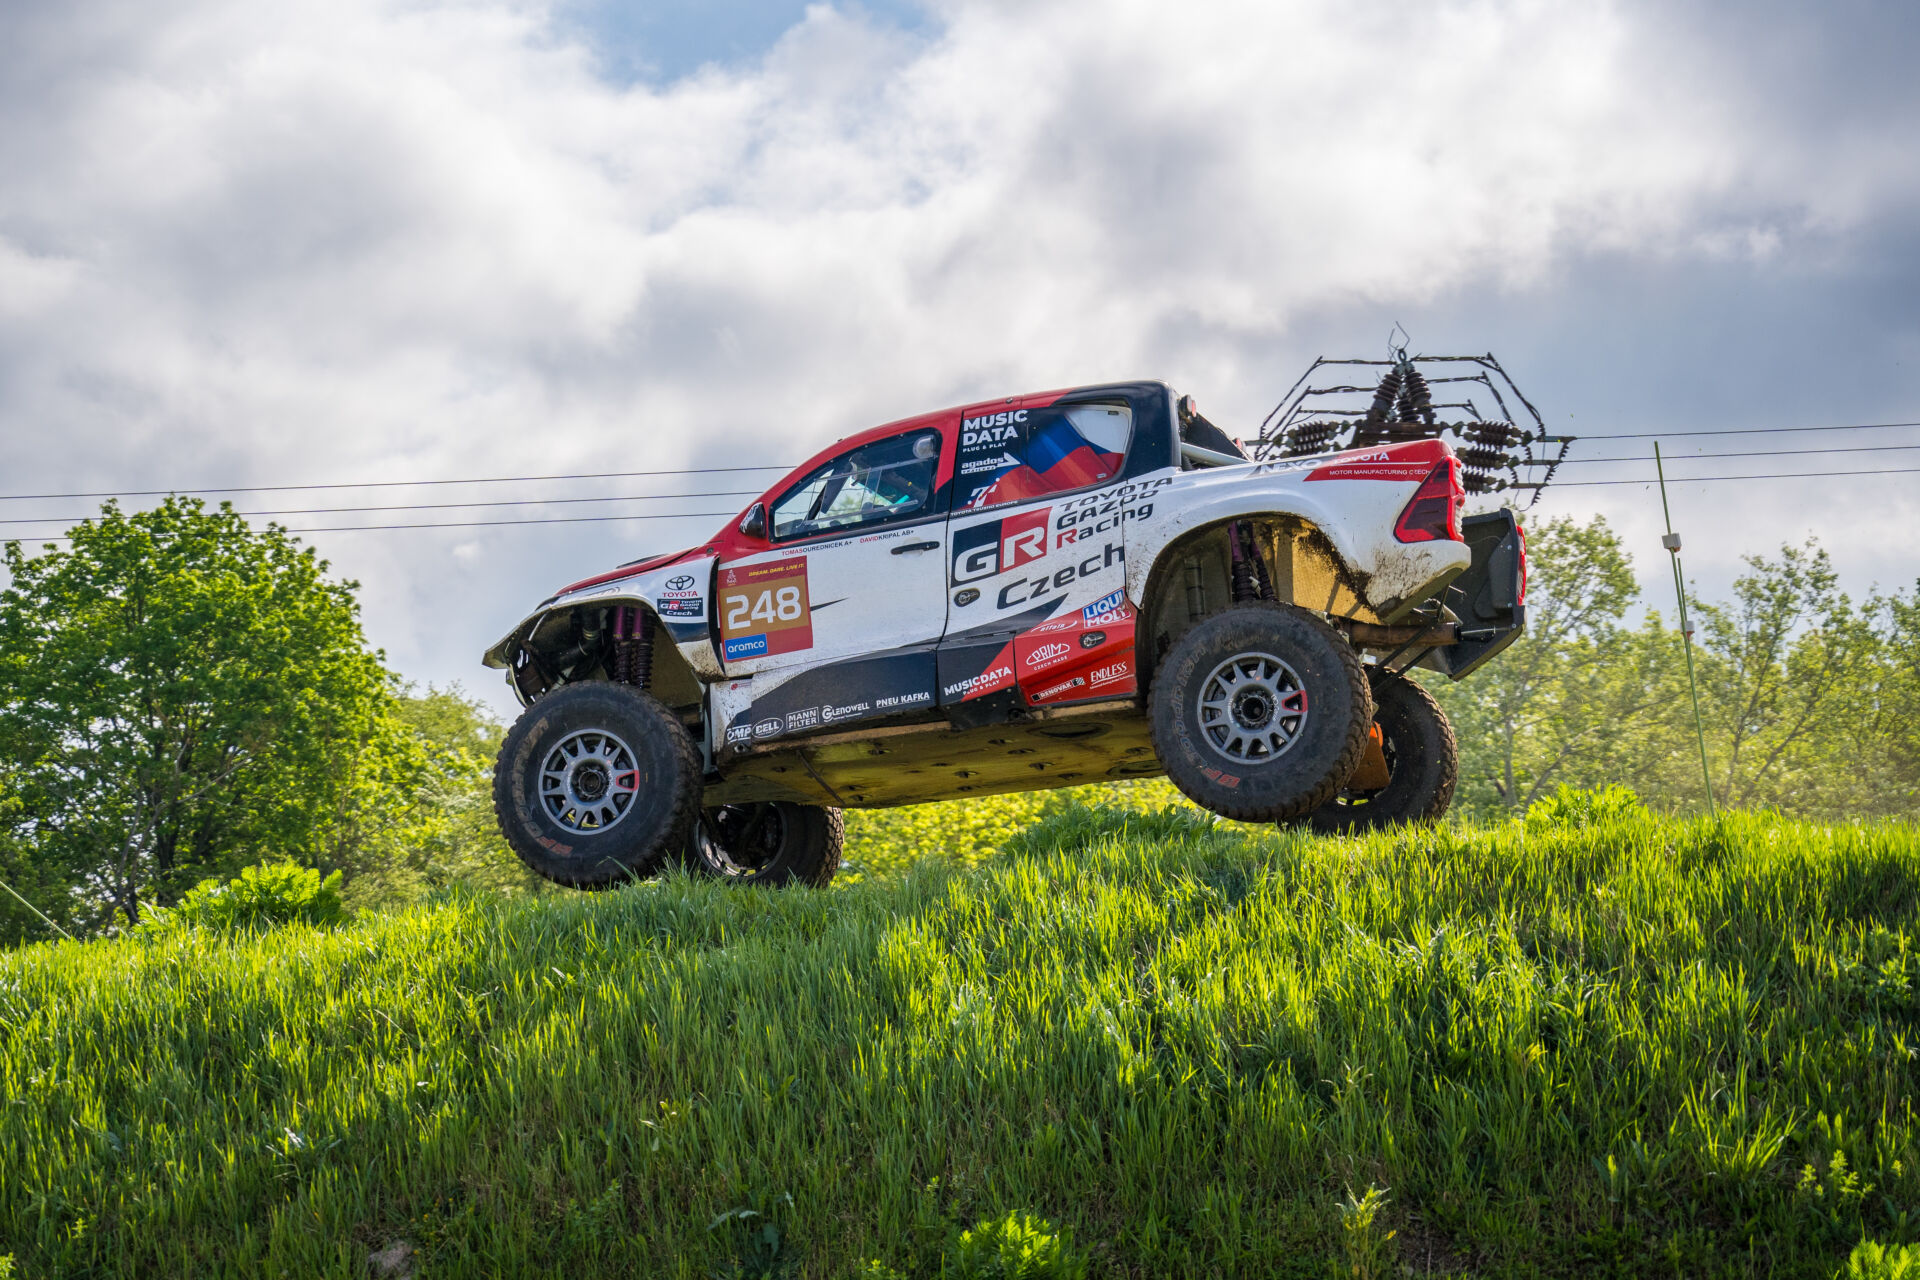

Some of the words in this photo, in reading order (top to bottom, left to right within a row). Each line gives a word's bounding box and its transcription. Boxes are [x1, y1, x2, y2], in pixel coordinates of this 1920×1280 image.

[963, 409, 1028, 431] MUSIC
[963, 425, 1018, 446] DATA
[961, 457, 1004, 469] agados
[1333, 452, 1390, 464] TOYOTA
[1060, 477, 1173, 511] TOYOTA
[1057, 490, 1158, 530] GAZOO
[1056, 503, 1153, 549] Racing
[954, 526, 1046, 582] GR
[997, 543, 1125, 609] Czech
[662, 590, 698, 598] TOYOTA
[726, 586, 802, 631] 248
[1085, 591, 1123, 619] LIQUI
[1087, 605, 1126, 627] MOLY
[727, 640, 765, 653] aramco
[1030, 643, 1063, 662] PRIM
[1033, 660, 1052, 671] CZECH
[1052, 655, 1068, 663] MADE
[1090, 661, 1128, 682] ENDLESS
[944, 666, 1012, 696] MUSICDATA
[962, 687, 978, 695] PLUG
[985, 680, 1000, 688] PLAY
[876, 696, 899, 708] PNEU
[900, 692, 930, 703] KAFKA
[788, 709, 817, 722] MANN
[788, 717, 817, 729] FILTER
[727, 727, 752, 740] OMP
[755, 721, 780, 734] BELL
